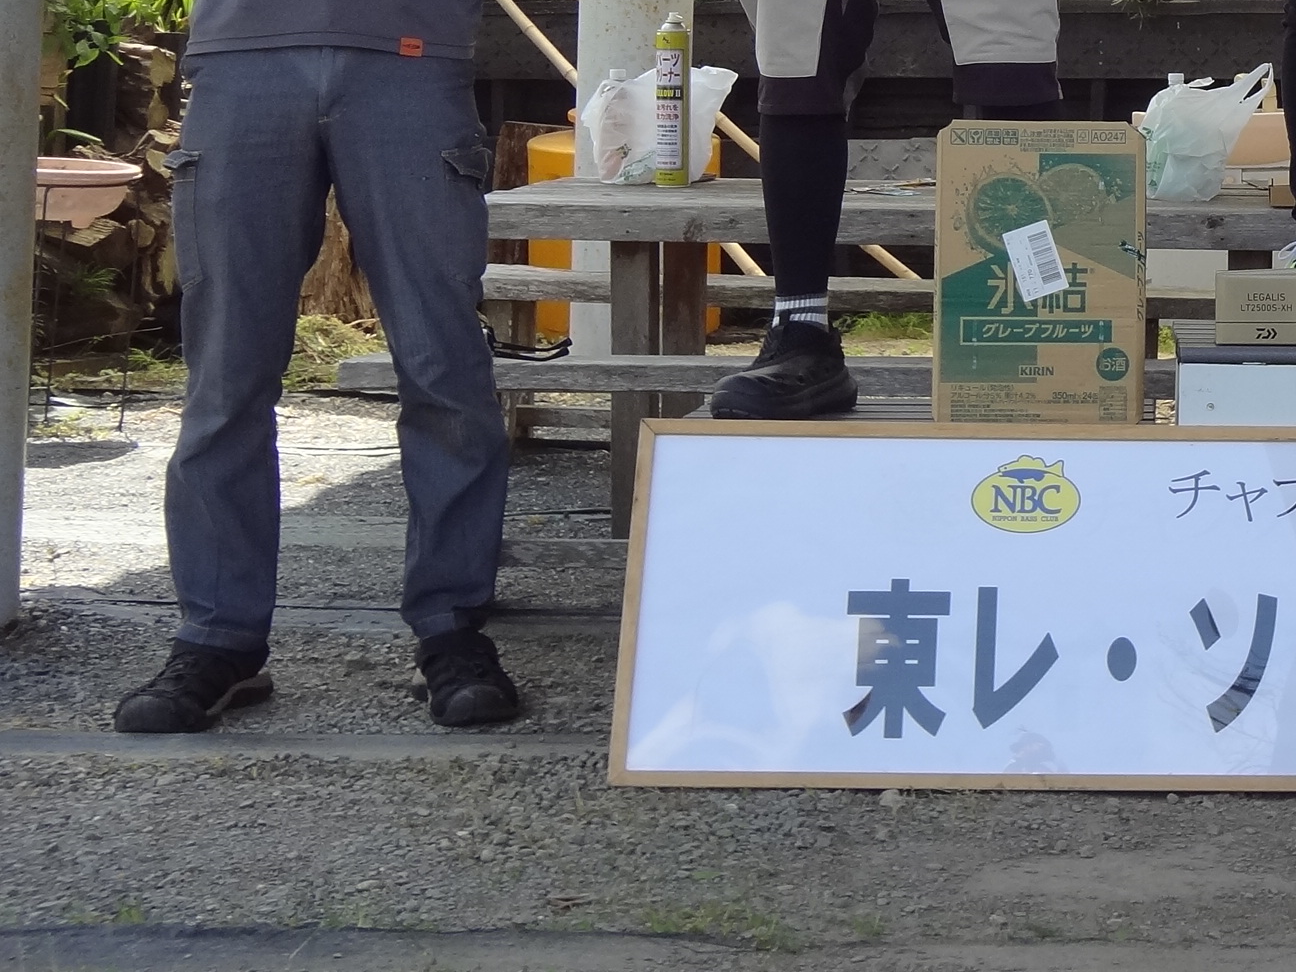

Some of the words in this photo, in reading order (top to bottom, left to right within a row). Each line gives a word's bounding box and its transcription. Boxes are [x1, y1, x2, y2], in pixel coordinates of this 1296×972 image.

[1247, 293, 1286, 302] LEGALIS
[1240, 303, 1293, 312] LT2500S-XH
[982, 324, 1095, 339] グレープフルーツ
[1019, 366, 1055, 377] KIRIN
[989, 484, 1062, 515] NBC
